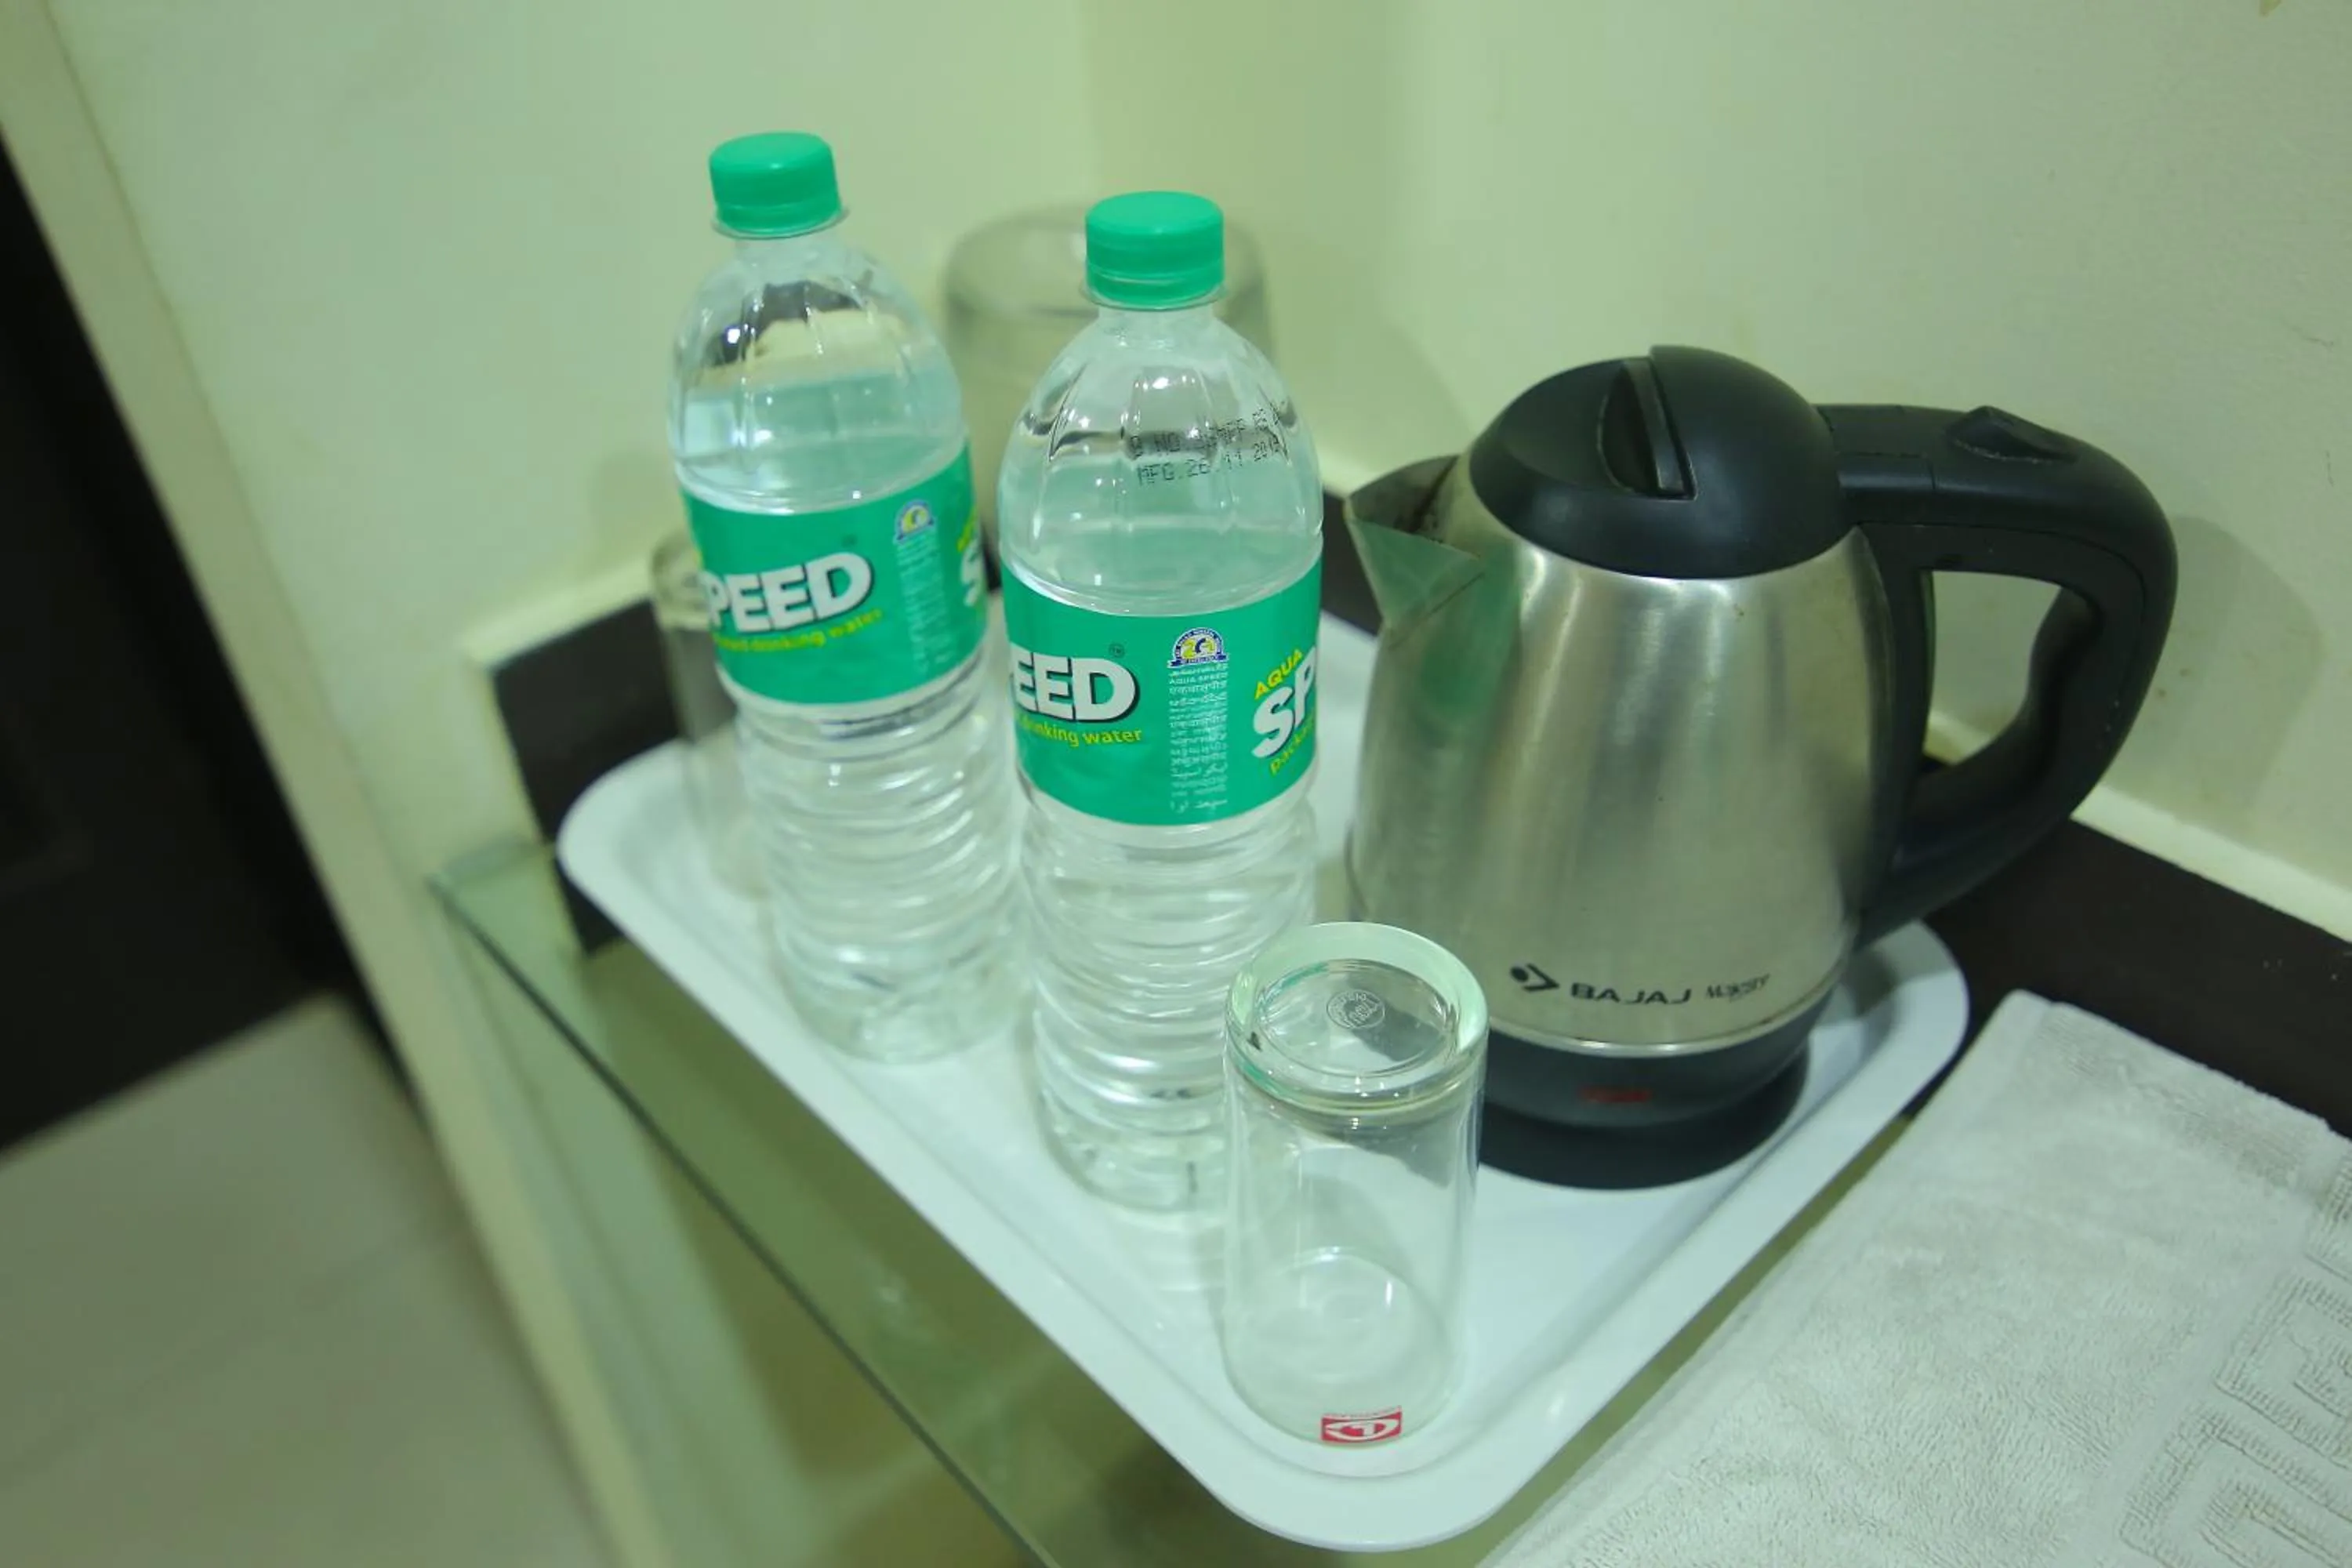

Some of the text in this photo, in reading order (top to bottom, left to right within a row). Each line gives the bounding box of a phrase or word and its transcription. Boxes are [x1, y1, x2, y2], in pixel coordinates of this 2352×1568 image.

[700, 552, 875, 633] PEED
[1011, 641, 1141, 724] EED
[1254, 648, 1303, 700] AQUA
[1082, 729, 1142, 746] water
[1570, 982, 1692, 1004] BAJAJ
